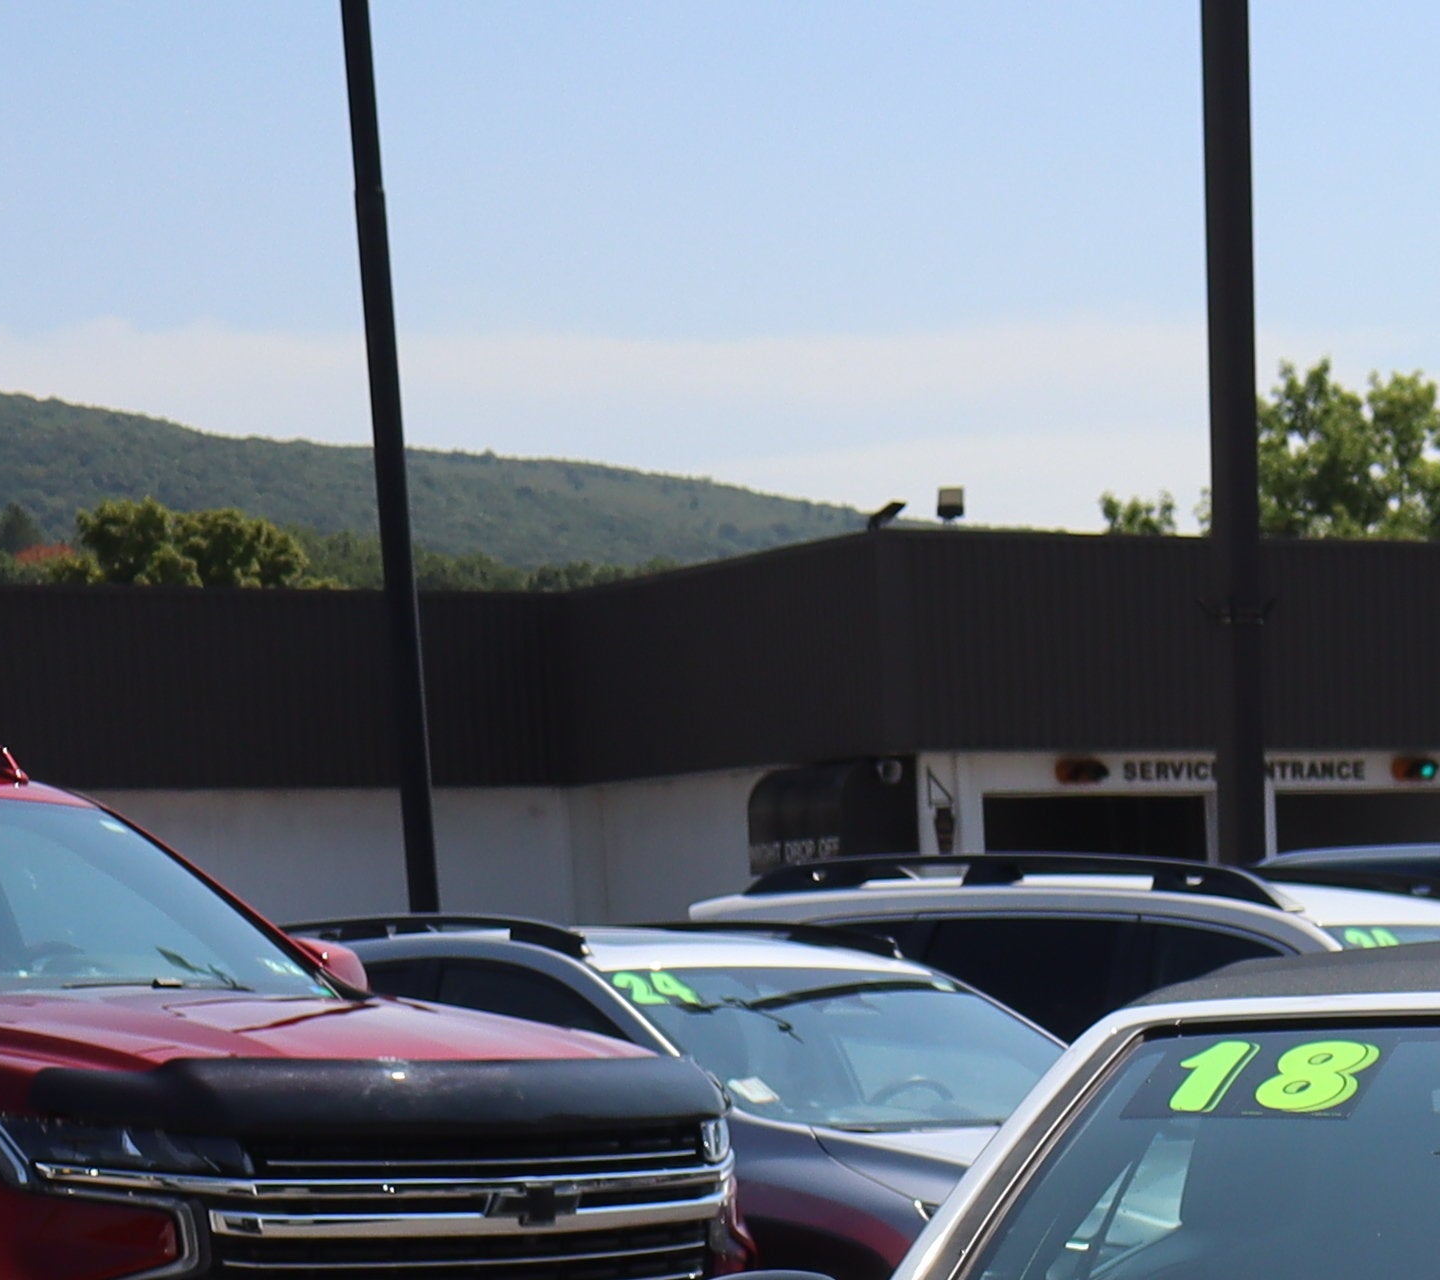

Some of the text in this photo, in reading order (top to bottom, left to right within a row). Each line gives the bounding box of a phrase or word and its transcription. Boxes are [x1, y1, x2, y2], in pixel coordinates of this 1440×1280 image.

[1264, 760, 1365, 782] NTRANCE
[611, 970, 702, 1005] 24
[1169, 1040, 1380, 1112] 18
